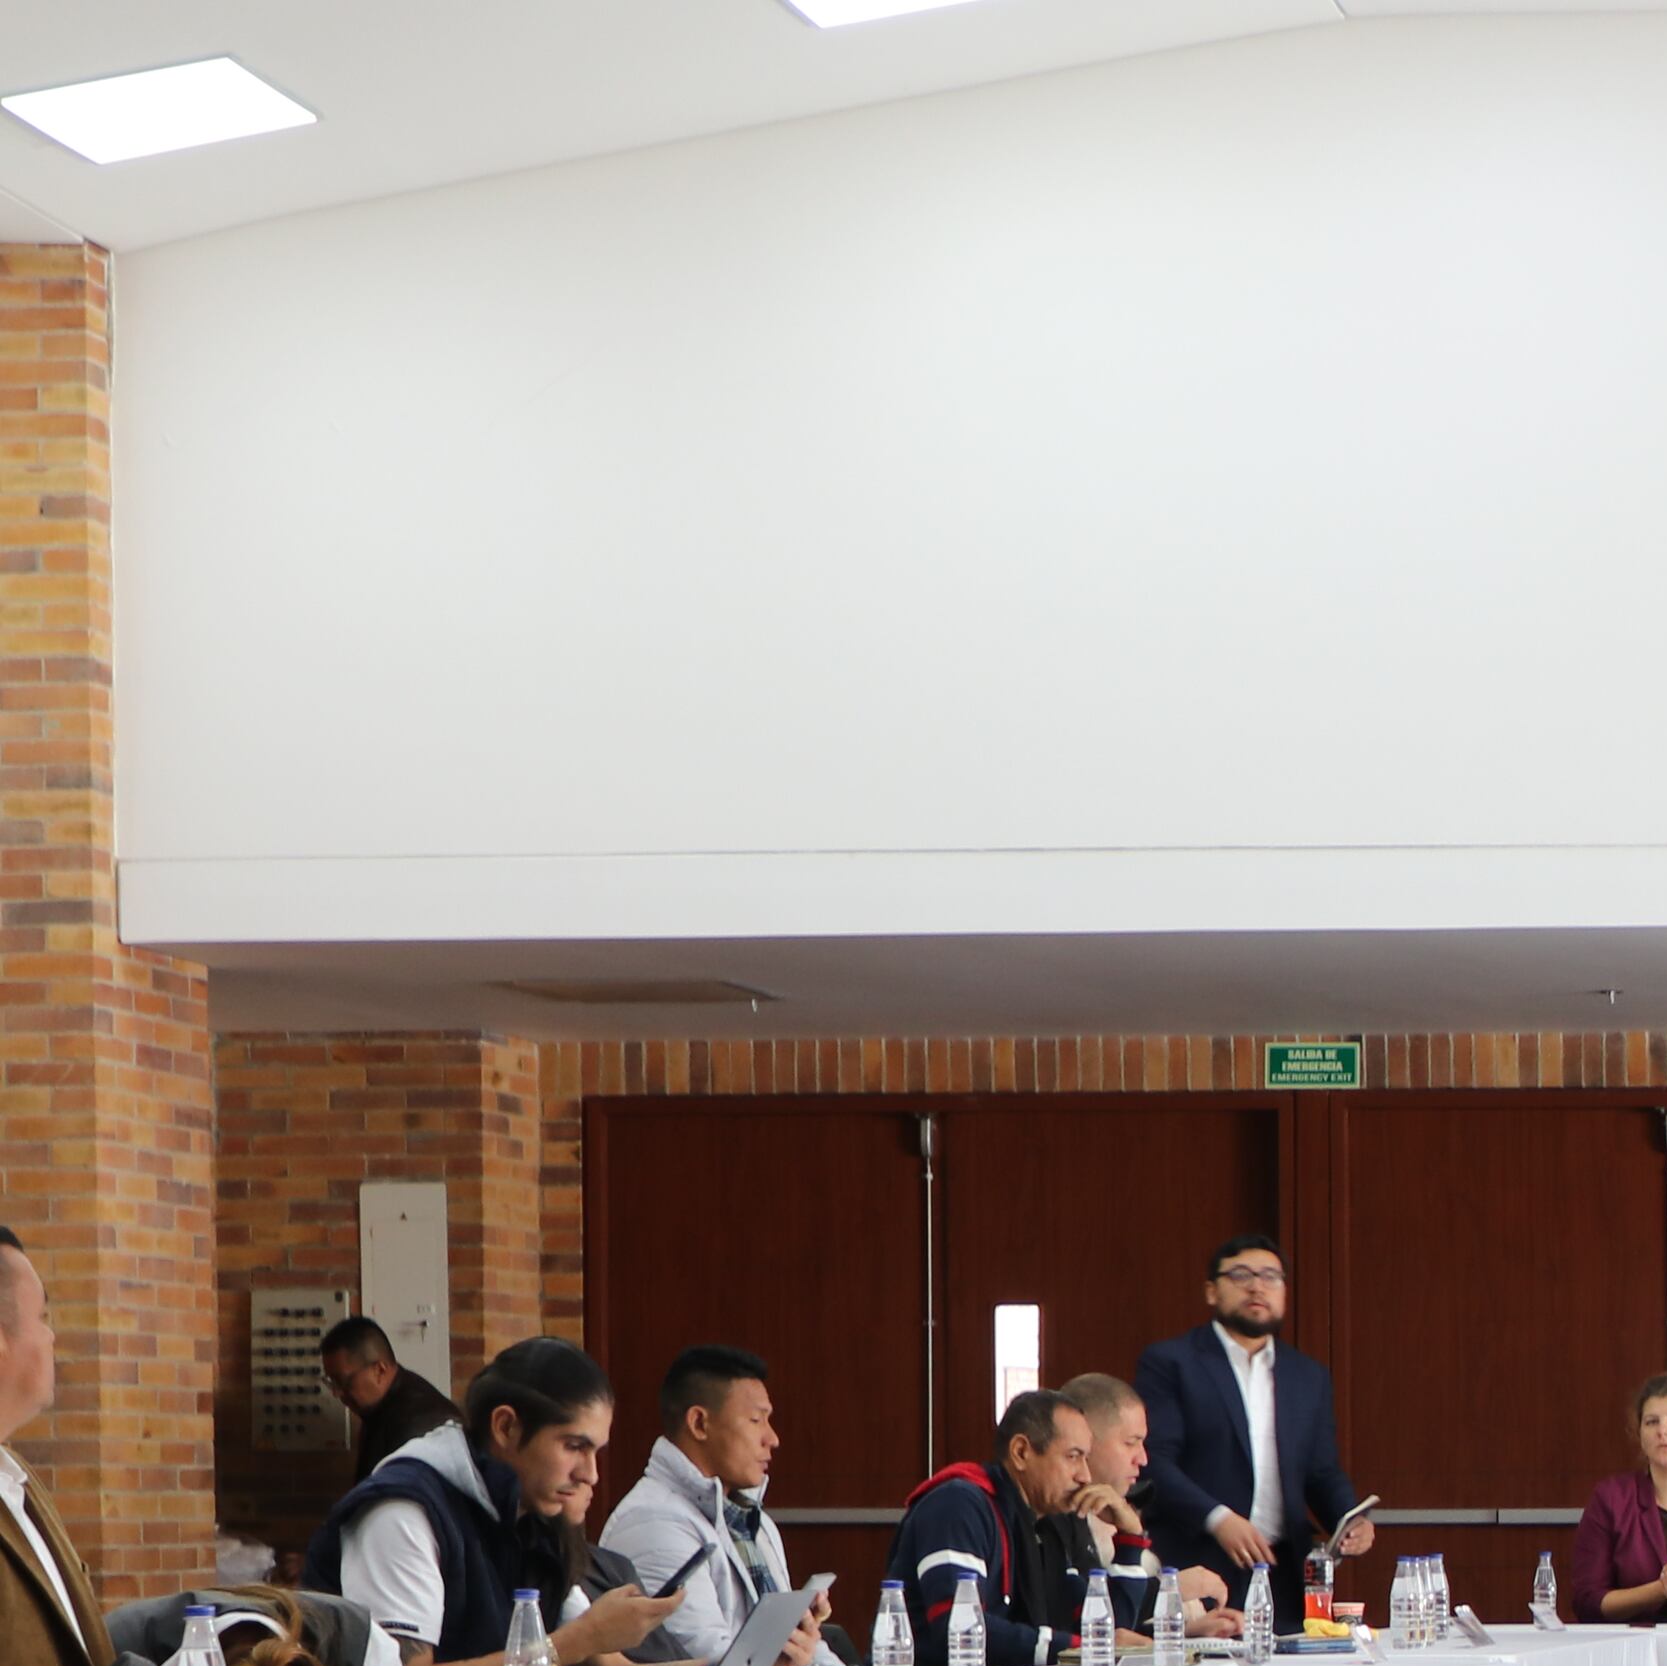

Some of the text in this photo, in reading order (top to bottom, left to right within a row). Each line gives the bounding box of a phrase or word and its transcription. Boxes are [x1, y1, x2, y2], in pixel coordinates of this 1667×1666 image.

[1288, 1049, 1338, 1060] SALIDA DE
[1281, 1061, 1344, 1072] EMERGENCIA
[1271, 1073, 1352, 1082] EMERGENCY EXIT
